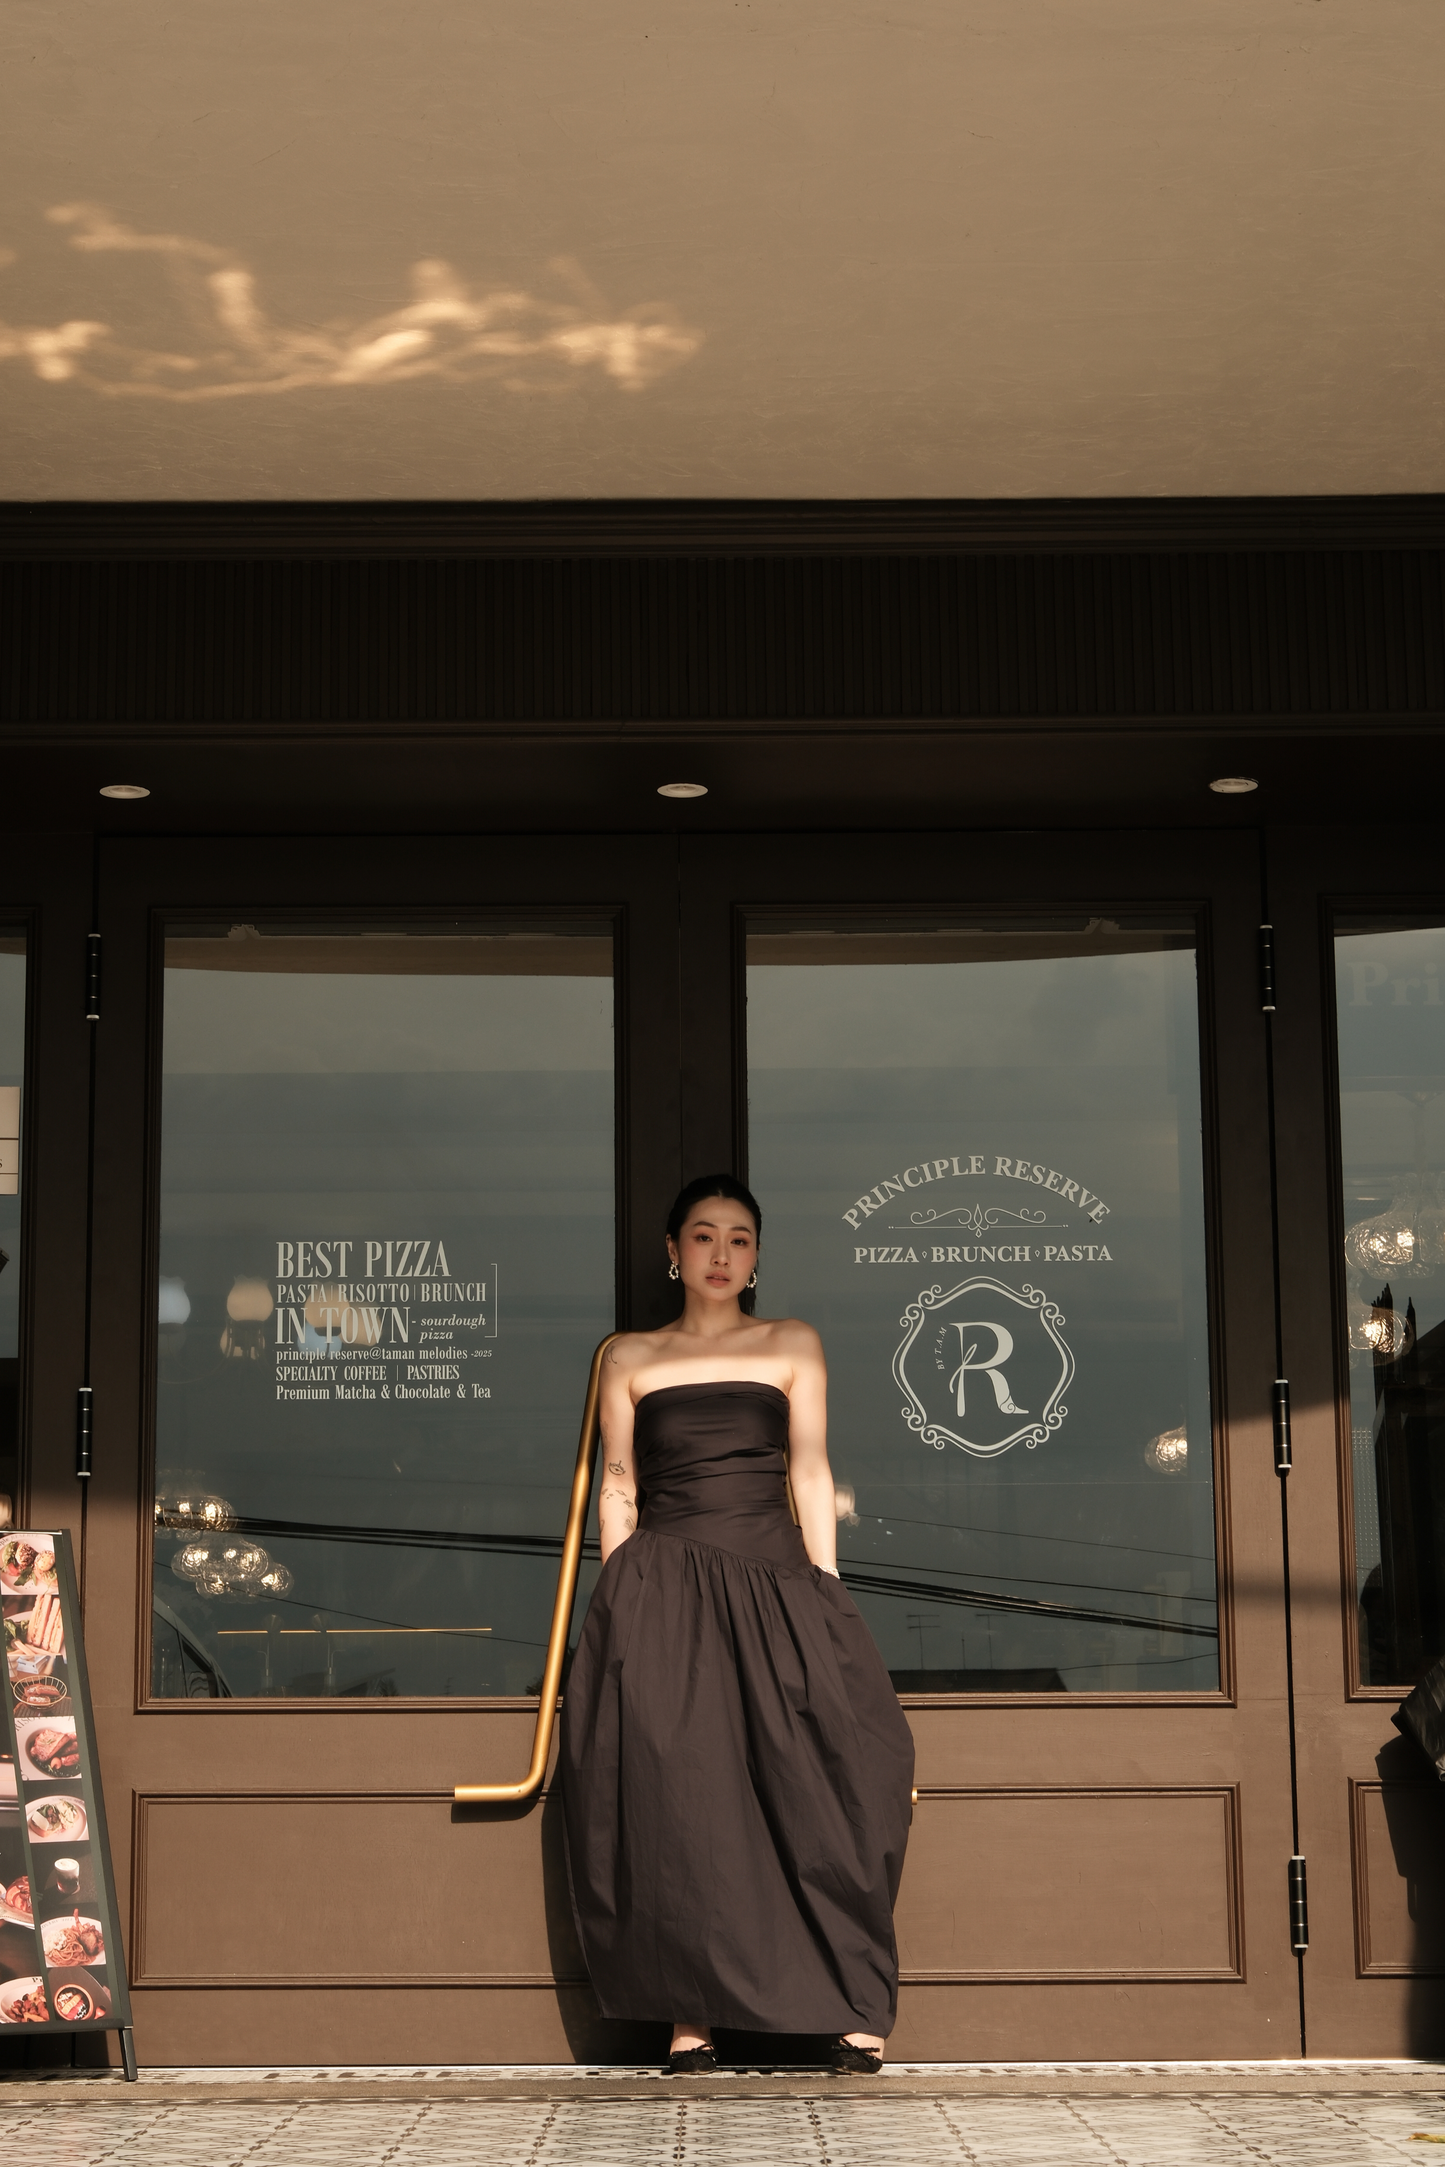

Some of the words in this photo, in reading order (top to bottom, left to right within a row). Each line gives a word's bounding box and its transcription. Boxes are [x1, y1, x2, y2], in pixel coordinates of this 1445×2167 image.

[841, 1155, 986, 1231] PRINCIPLE
[993, 1156, 1111, 1225] RESERVE
[275, 1241, 353, 1278] BEST
[364, 1240, 452, 1278] PIZZA
[853, 1247, 920, 1264] PIZZA
[930, 1245, 1031, 1263] BRUNCH
[1043, 1244, 1114, 1262] PASTA
[276, 1283, 328, 1304] PASTA
[337, 1282, 410, 1303] RISOTTO
[420, 1282, 487, 1303] BRUNCH
[274, 1307, 308, 1345] IN
[420, 1313, 487, 1331] sourdough
[418, 1329, 454, 1344] pizza
[276, 1347, 327, 1364] principle
[329, 1346, 415, 1361] reserve@taman
[418, 1346, 468, 1360] melodies
[275, 1365, 339, 1382] SPECIALTY
[343, 1365, 387, 1381] COFFEE
[406, 1364, 460, 1380] PASTRIES
[276, 1385, 331, 1401] Premium
[334, 1384, 377, 1400] Matcha
[380, 1383, 391, 1400] &
[394, 1383, 451, 1400] Chocolate
[456, 1383, 467, 1399] &
[471, 1383, 492, 1399] Tea
